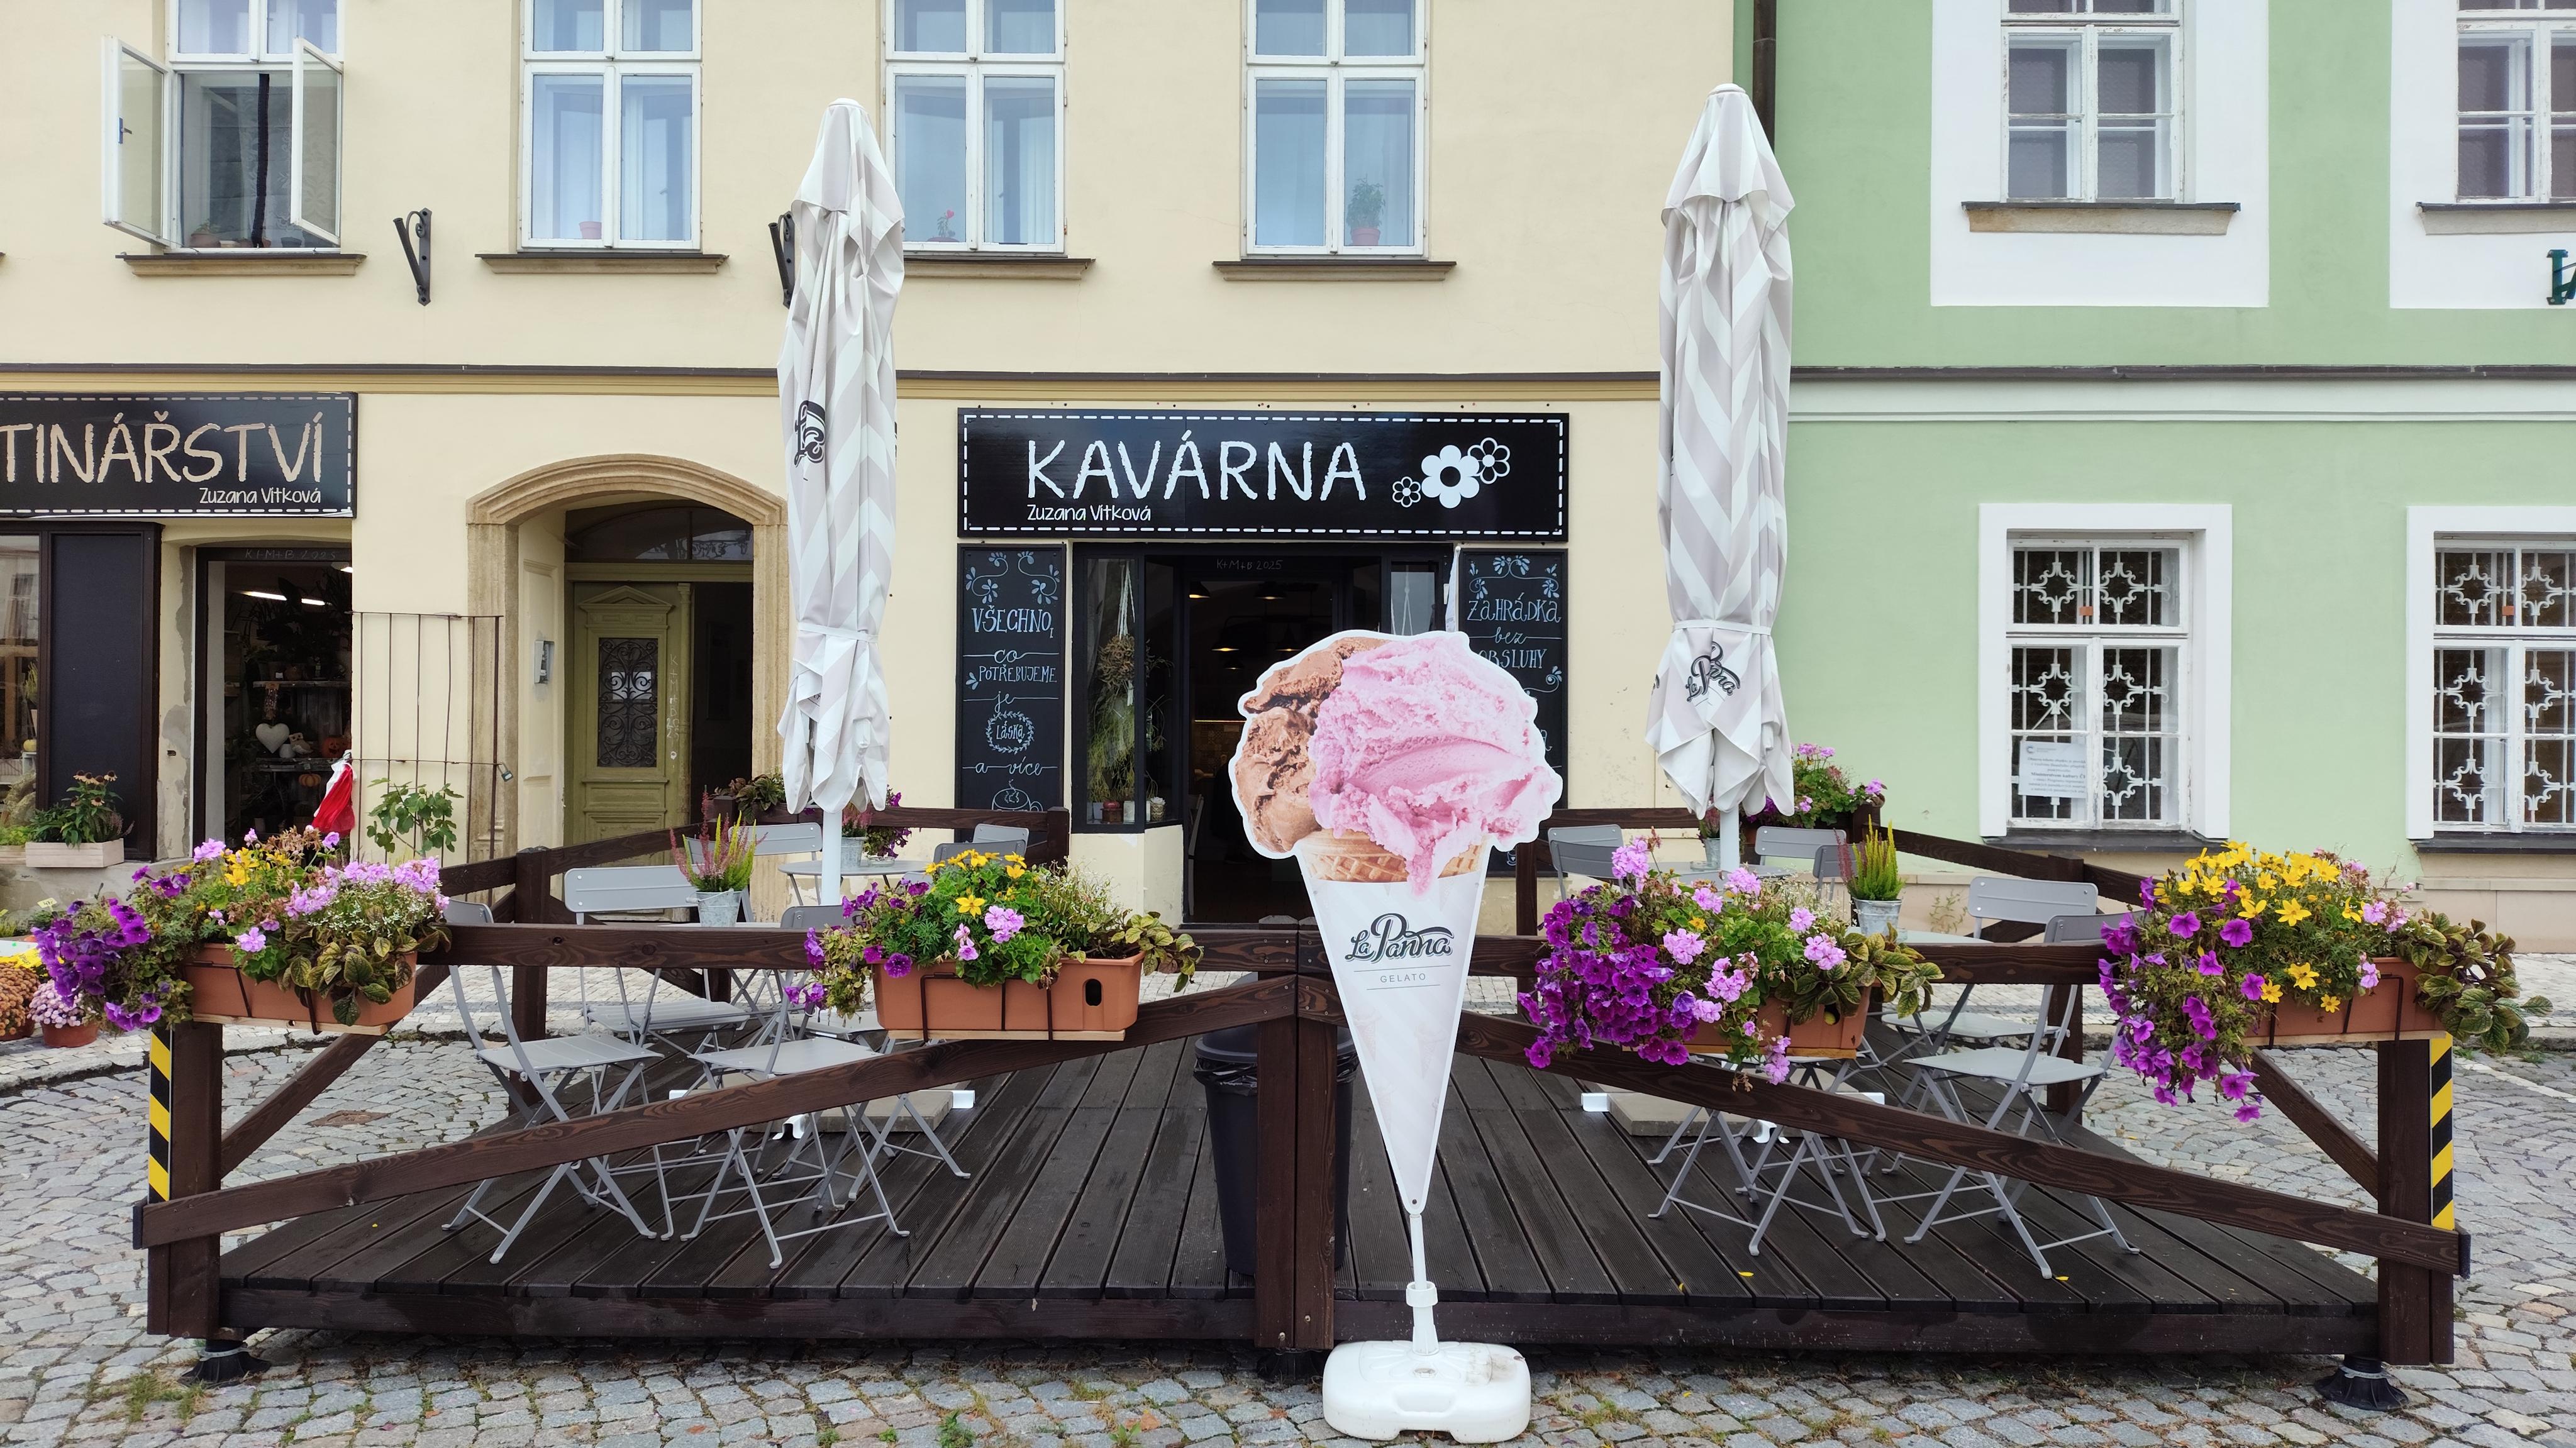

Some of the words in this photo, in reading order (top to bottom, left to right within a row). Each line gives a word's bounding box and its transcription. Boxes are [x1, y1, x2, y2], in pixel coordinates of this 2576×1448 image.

[0, 410, 324, 484] TINÁŘSTVÍ
[1027, 429, 1367, 501] KAVÁRNA
[199, 487, 257, 504] Zuzana
[261, 487, 321, 504] Vítková
[1027, 504, 1086, 521] Zuzana
[1091, 504, 1151, 522] Vítková
[1256, 559, 1284, 570] 2025
[1494, 626, 1528, 644] bez
[994, 649, 1018, 664] co
[994, 690, 1015, 713] je
[975, 762, 989, 774] a
[1008, 756, 1043, 776] více
[1345, 929, 1375, 961] La
[1370, 913, 1454, 964] Panna
[1380, 973, 1426, 983] GELATO
